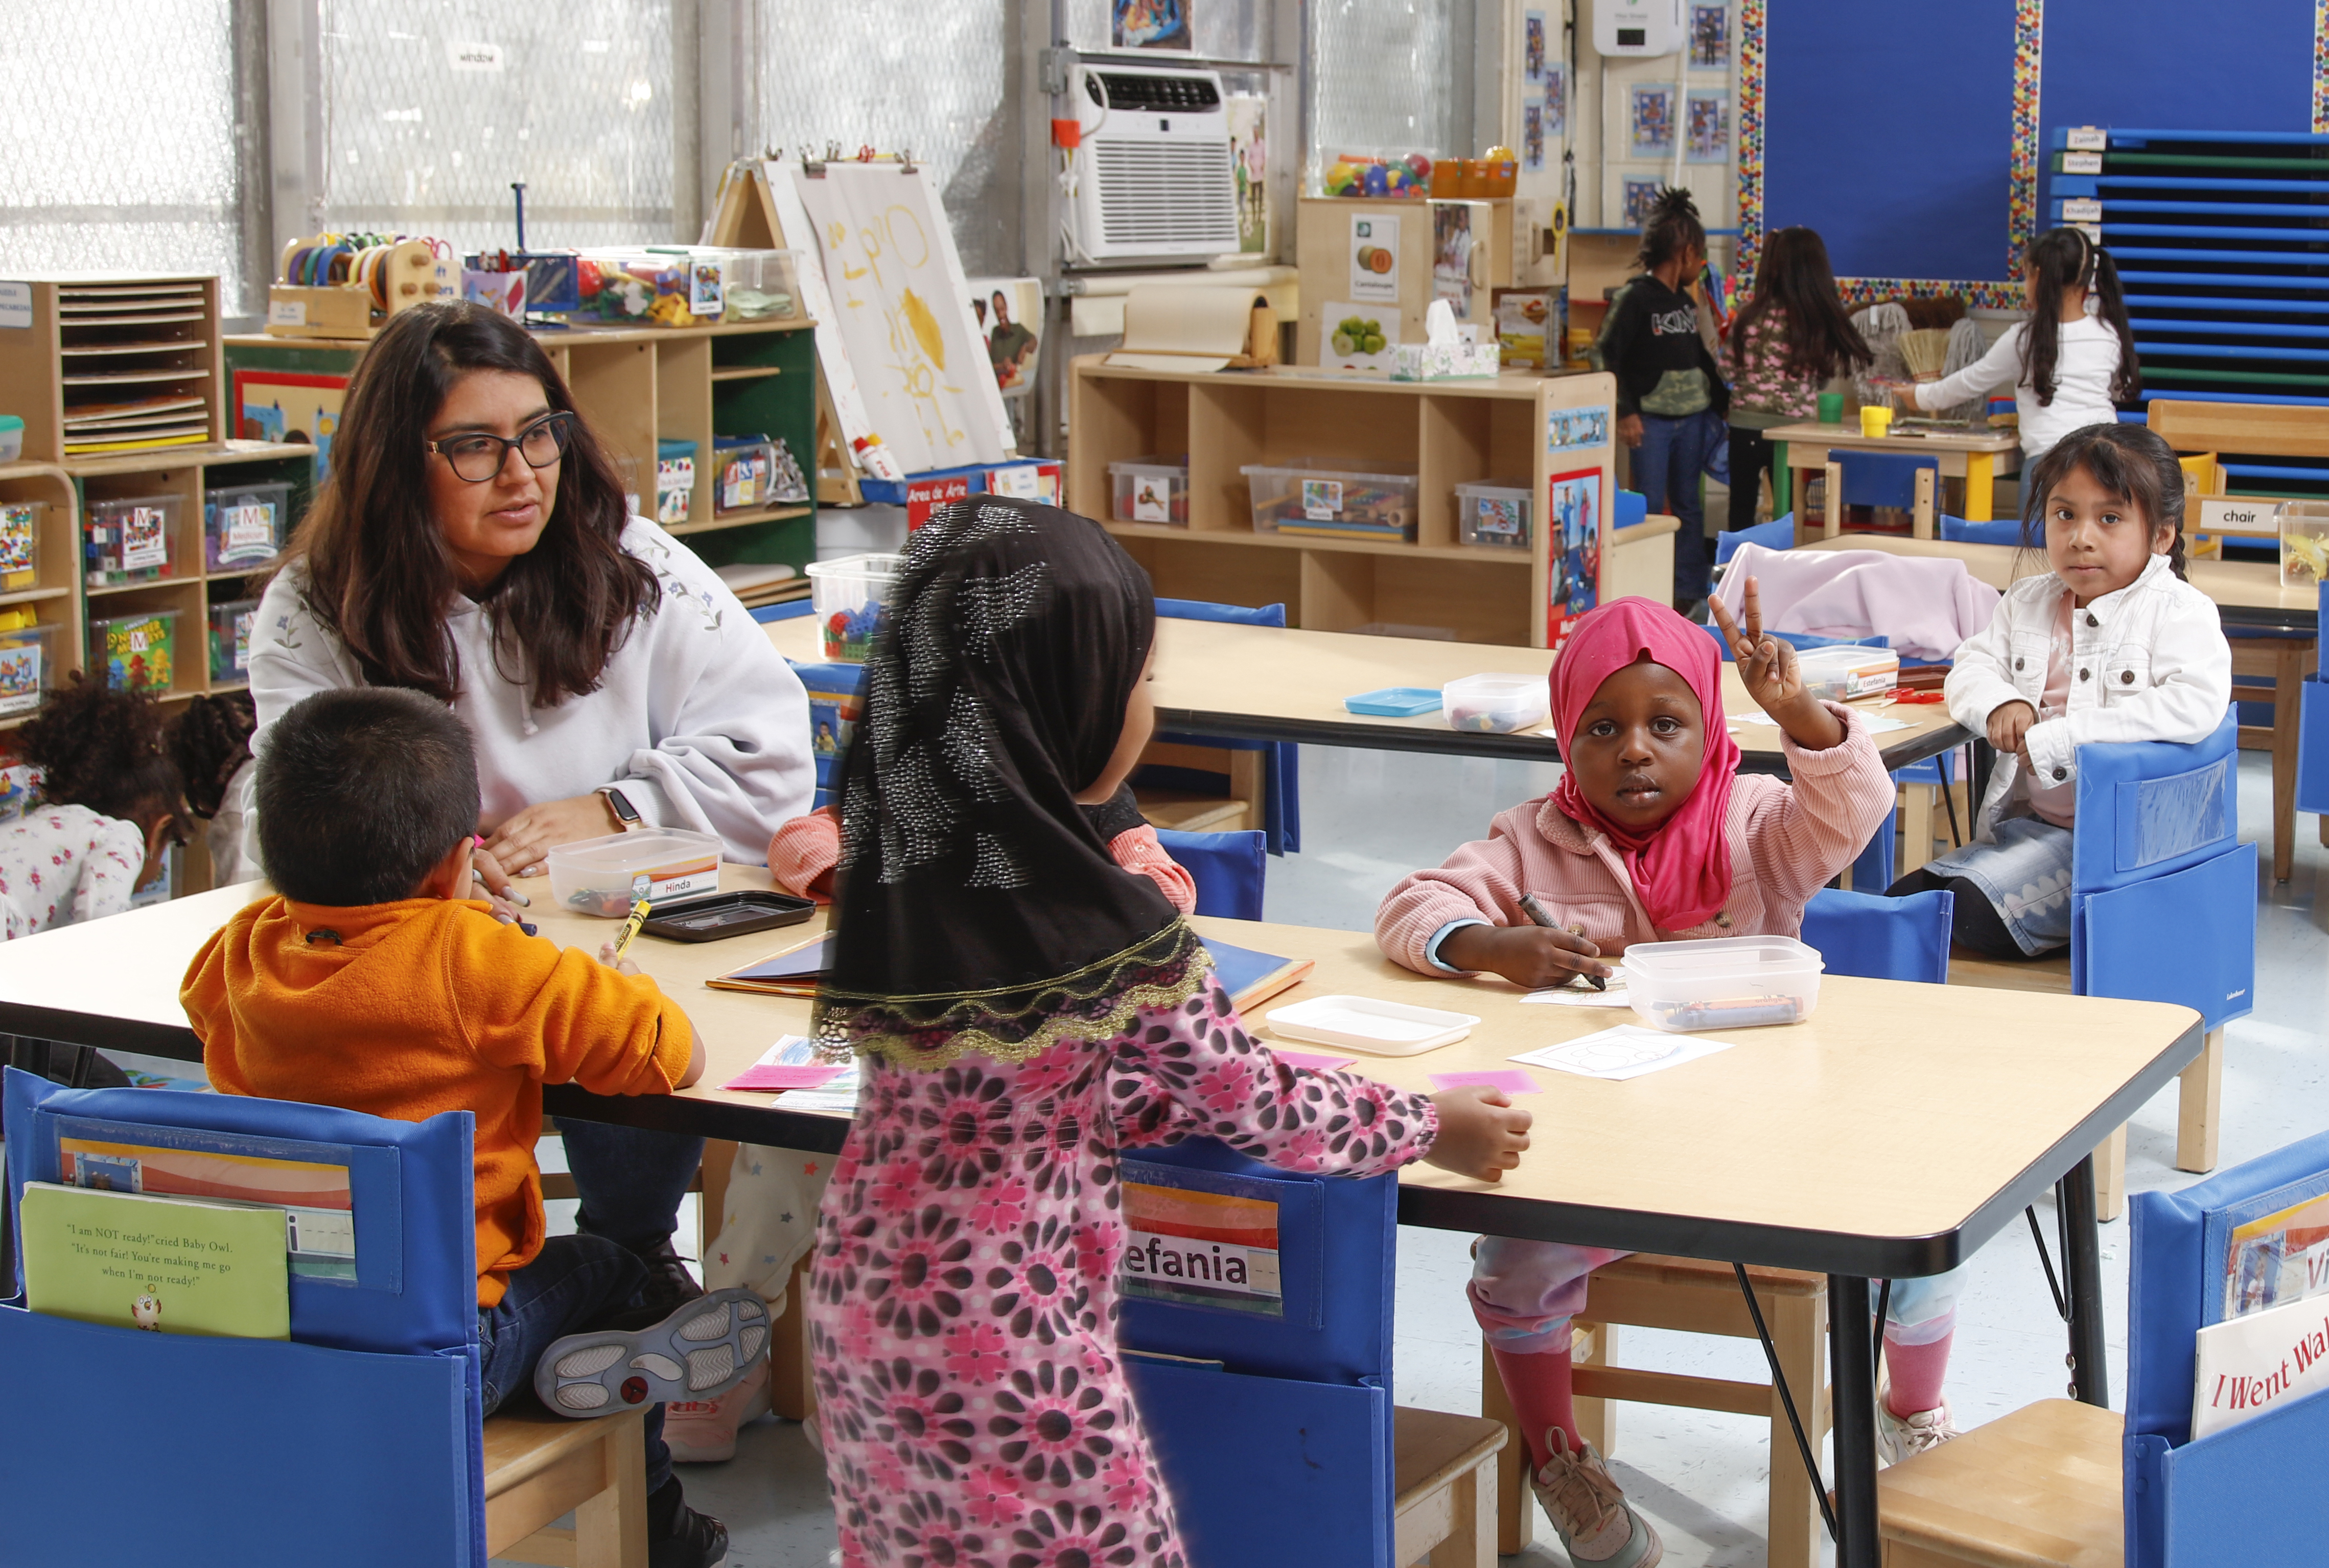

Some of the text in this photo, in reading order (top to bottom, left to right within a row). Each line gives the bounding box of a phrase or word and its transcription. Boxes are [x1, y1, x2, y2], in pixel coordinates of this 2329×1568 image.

[459, 50, 494, 62] window
[876, 460, 892, 478] red
[907, 488, 930, 503] Area
[932, 485, 943, 500] de
[137, 509, 151, 525] M
[244, 508, 259, 525] M
[2224, 510, 2256, 523] chair
[134, 633, 148, 649] M
[1864, 676, 1886, 688] Estefania
[666, 879, 690, 893] Hinda
[2226, 989, 2246, 1000] Lakeshore
[96, 1227, 119, 1239] NOT
[155, 1236, 179, 1247] cried
[183, 1238, 205, 1252] Baby
[209, 1242, 232, 1252] Owl.
[93, 1248, 107, 1256] not
[111, 1248, 128, 1259] fair!
[132, 1251, 160, 1263] You’re
[164, 1256, 199, 1270] making
[219, 1264, 230, 1273] go
[1125, 1237, 1247, 1284] efania
[102, 1266, 125, 1277] when
[129, 1270, 144, 1280] I’m
[167, 1275, 200, 1288] ready!”
[2211, 1373, 2227, 1408] I
[2229, 1358, 2291, 1410] Went
